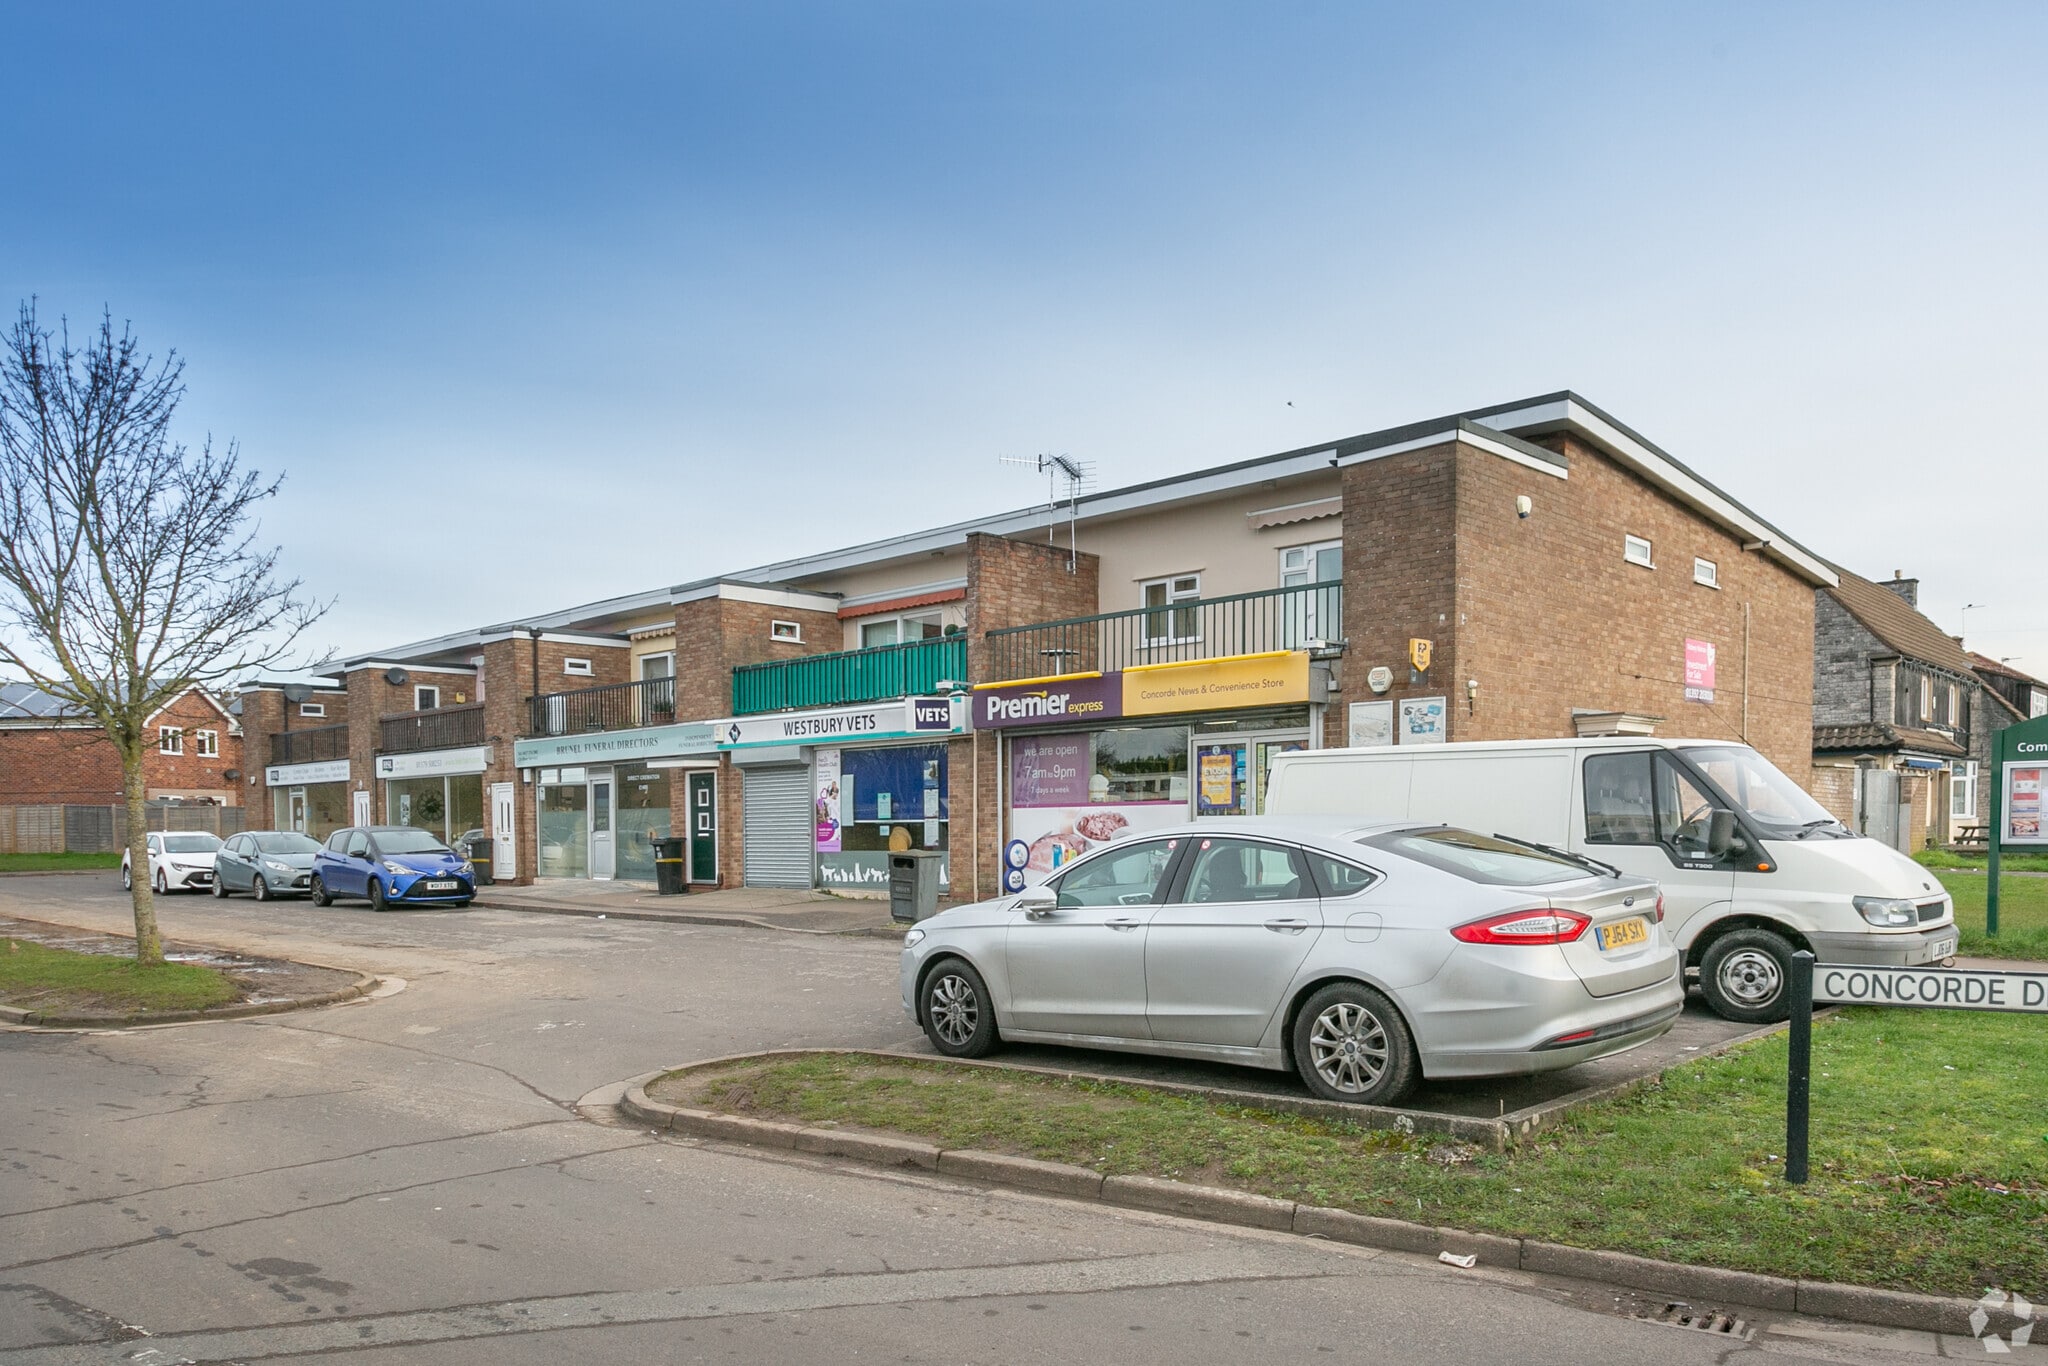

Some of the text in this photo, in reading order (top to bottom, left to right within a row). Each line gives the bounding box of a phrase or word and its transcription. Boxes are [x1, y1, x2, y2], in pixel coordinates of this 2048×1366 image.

[1140, 678, 1285, 700] Concorde News & Convenience Store
[916, 707, 949, 722] VETS
[987, 691, 1103, 721] Premier express
[784, 715, 876, 736] WESTBURY VETS
[556, 737, 659, 756] BRUNEL FUNERAL DIRECTORS
[1024, 746, 1078, 758] we are open
[1025, 765, 1047, 779] 7am
[1053, 764, 1077, 780] 9pm
[1035, 787, 1049, 795] days
[1055, 785, 1070, 793] week
[1603, 920, 1645, 946] PJ64 SXY
[1825, 971, 2048, 1007] CONCORDE D
